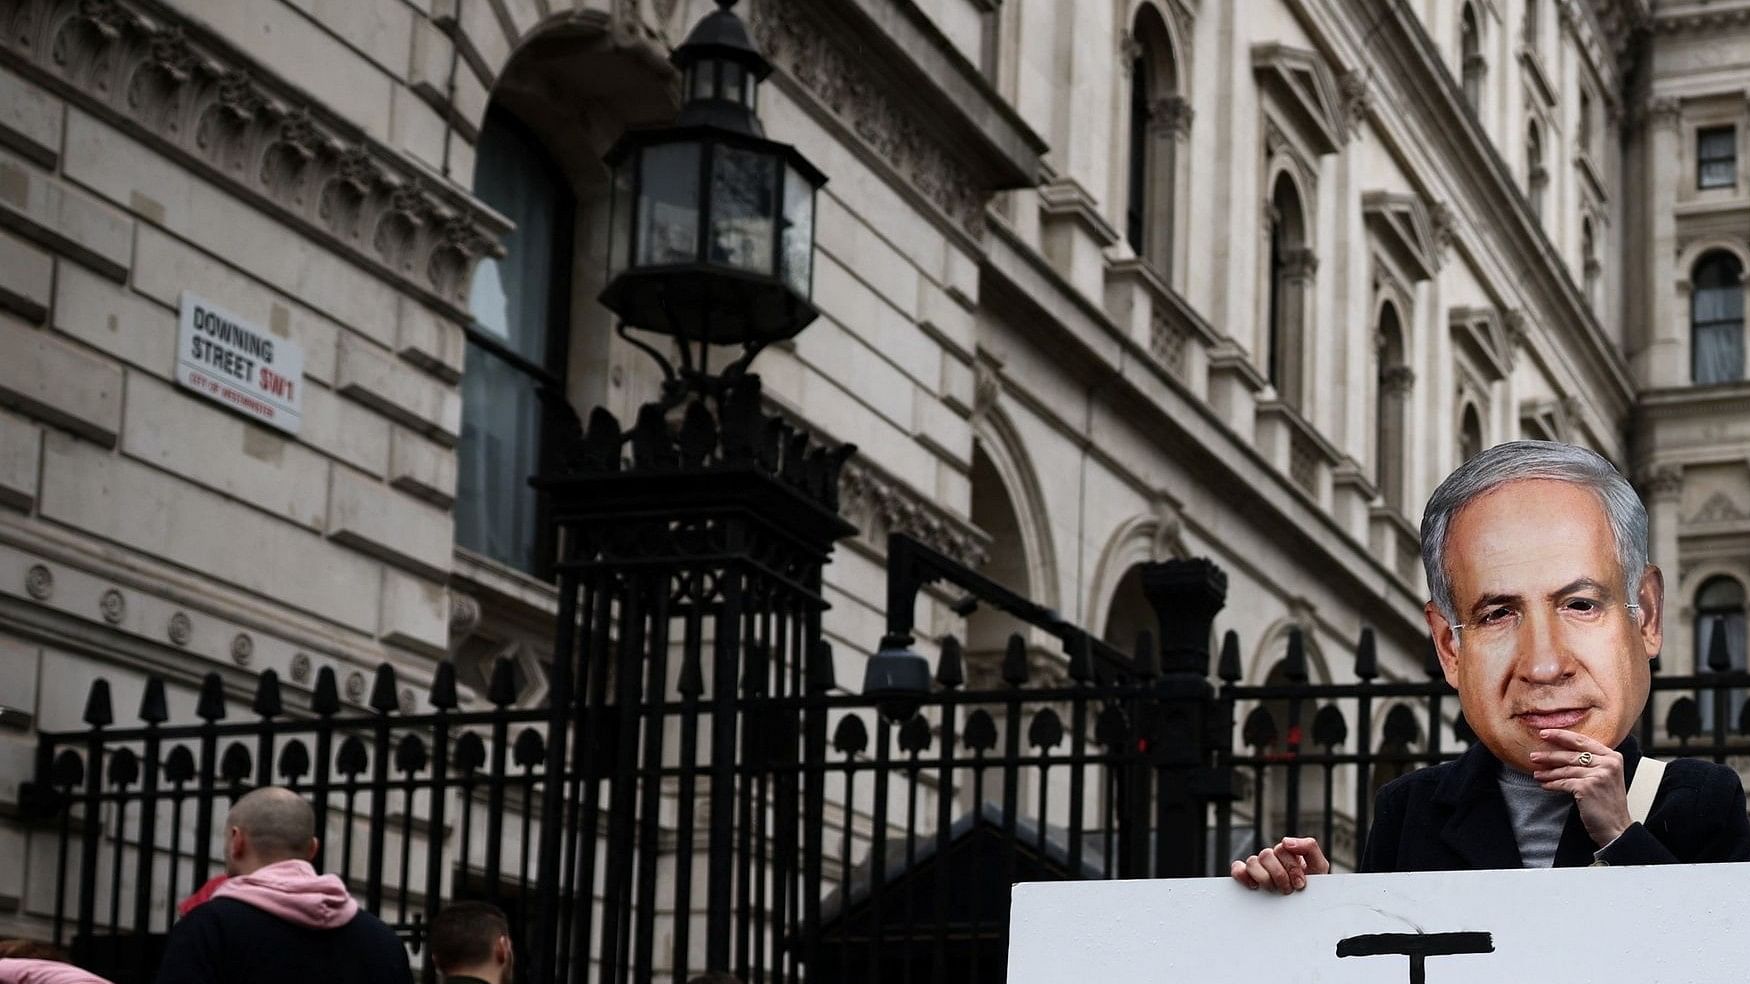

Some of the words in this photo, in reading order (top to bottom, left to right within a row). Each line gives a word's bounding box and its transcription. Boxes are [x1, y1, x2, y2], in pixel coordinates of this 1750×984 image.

[193, 306, 274, 364] DOWNING
[191, 335, 254, 382] STREET
[259, 367, 295, 404] SW1
